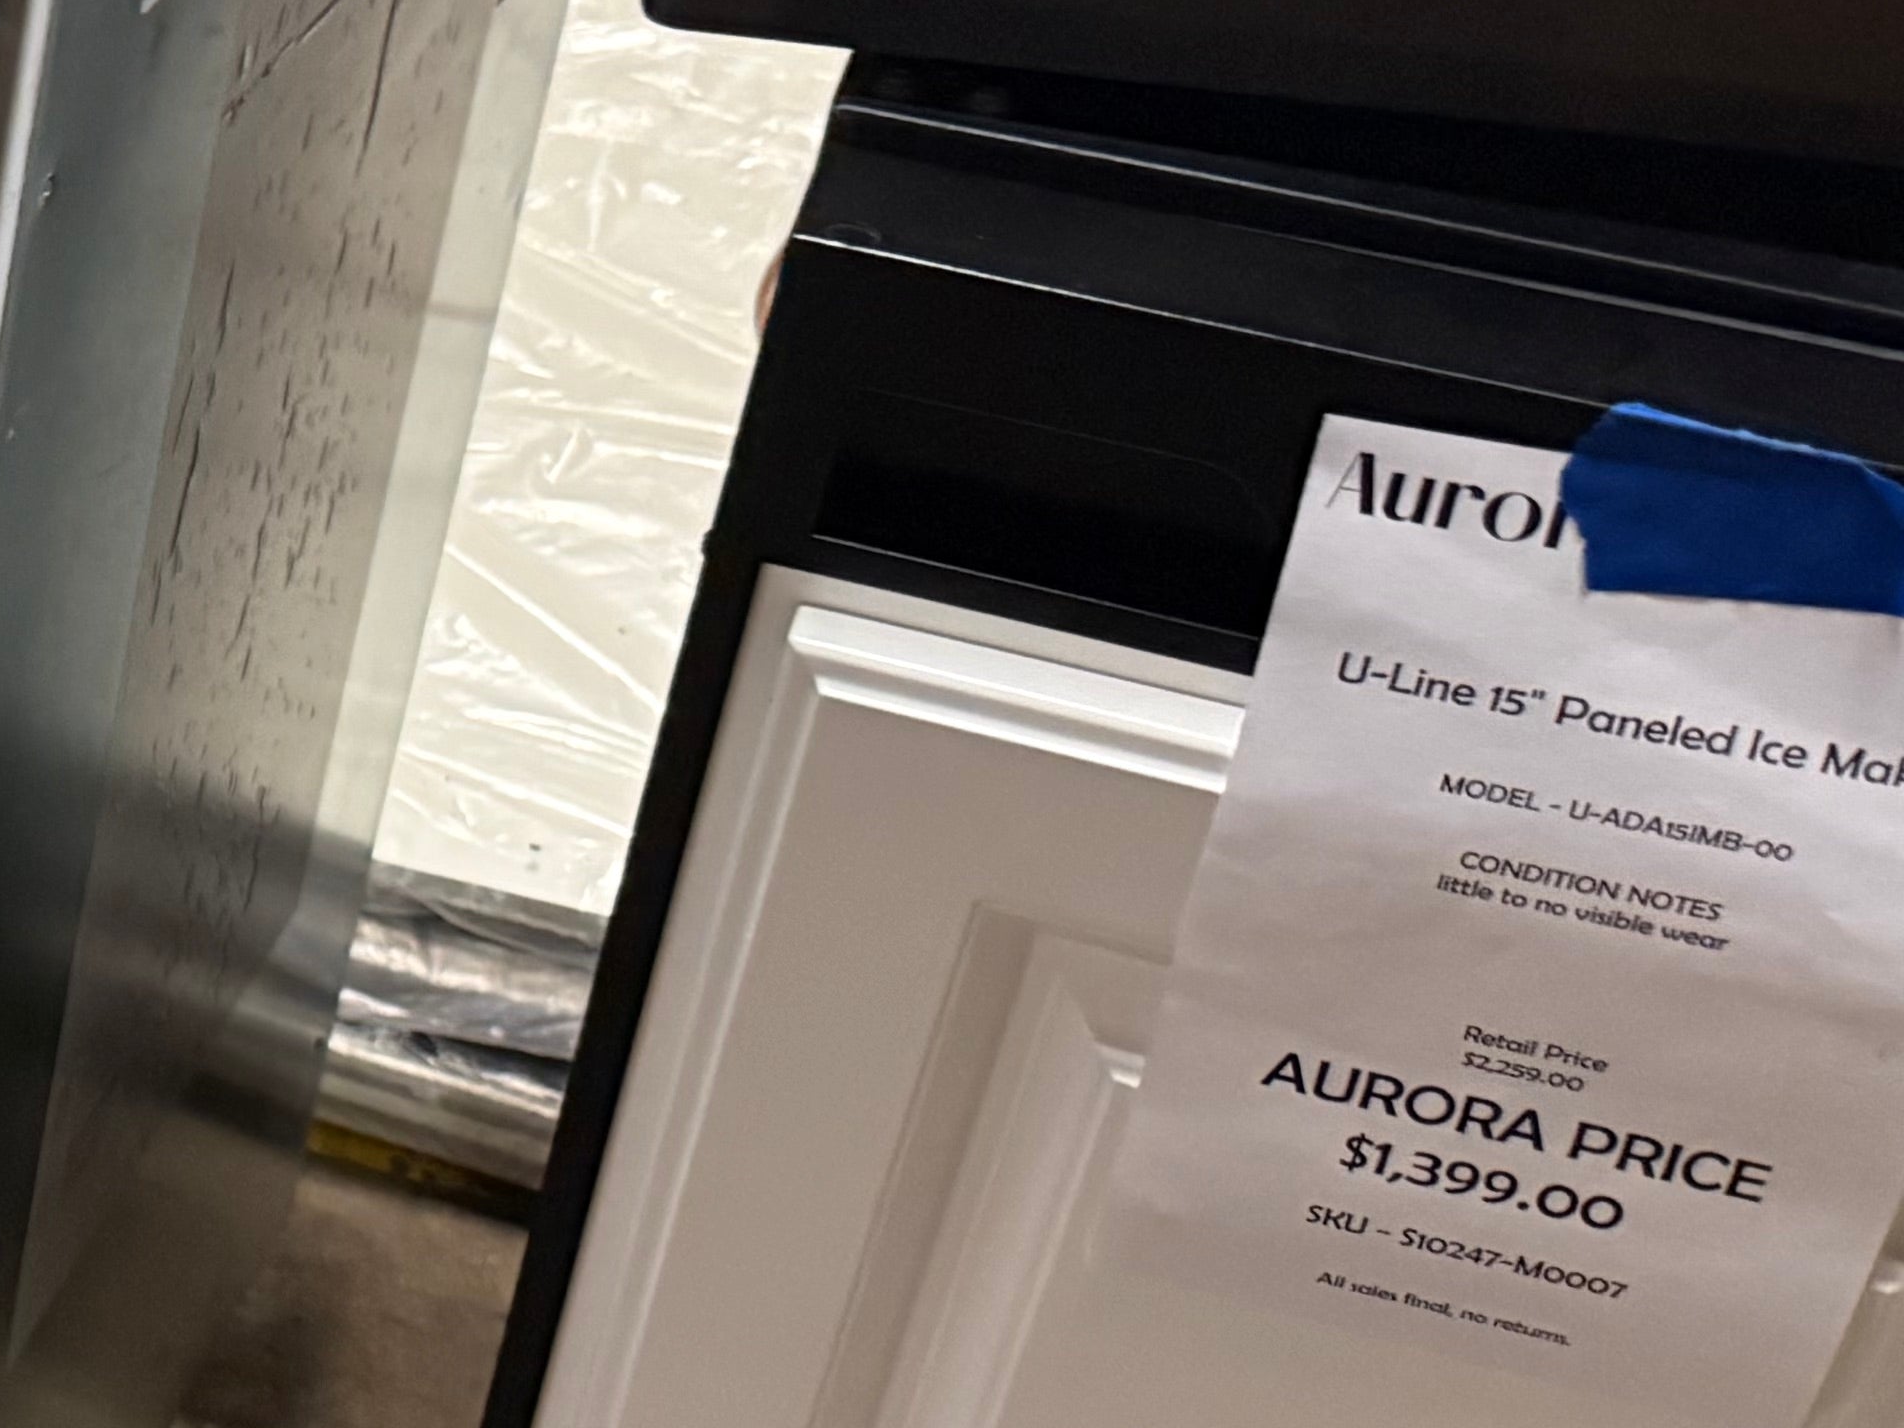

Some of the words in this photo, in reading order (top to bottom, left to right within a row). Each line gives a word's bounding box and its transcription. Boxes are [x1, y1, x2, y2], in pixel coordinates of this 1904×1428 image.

[1324, 451, 1567, 550] Auro
[1337, 651, 1477, 707] U-Line
[1489, 685, 1547, 717] 15"
[1554, 693, 1740, 757] Paneled
[1747, 729, 1808, 769] Ice
[1440, 773, 1541, 812] MODEL
[1436, 874, 1493, 901] little
[1501, 888, 1528, 908] to
[1534, 897, 1568, 917] no
[1574, 905, 1655, 936] visible
[1660, 925, 1730, 951] wear
[1460, 851, 1621, 901] CONDITION
[1626, 886, 1725, 922] NOTES
[1463, 1024, 1539, 1057] Retail
[1544, 1043, 1609, 1073] Price
[1258, 1051, 1548, 1153] AURORA
[1568, 1122, 1774, 1205] PRICE
[1338, 1132, 1624, 1231] $1,399.00
[1305, 1205, 1369, 1235] SKU
[1399, 1228, 1629, 1300] S10247-M0007
[1316, 1271, 1346, 1289] All
[1349, 1280, 1397, 1303] sales
[1460, 1309, 1488, 1325] no
